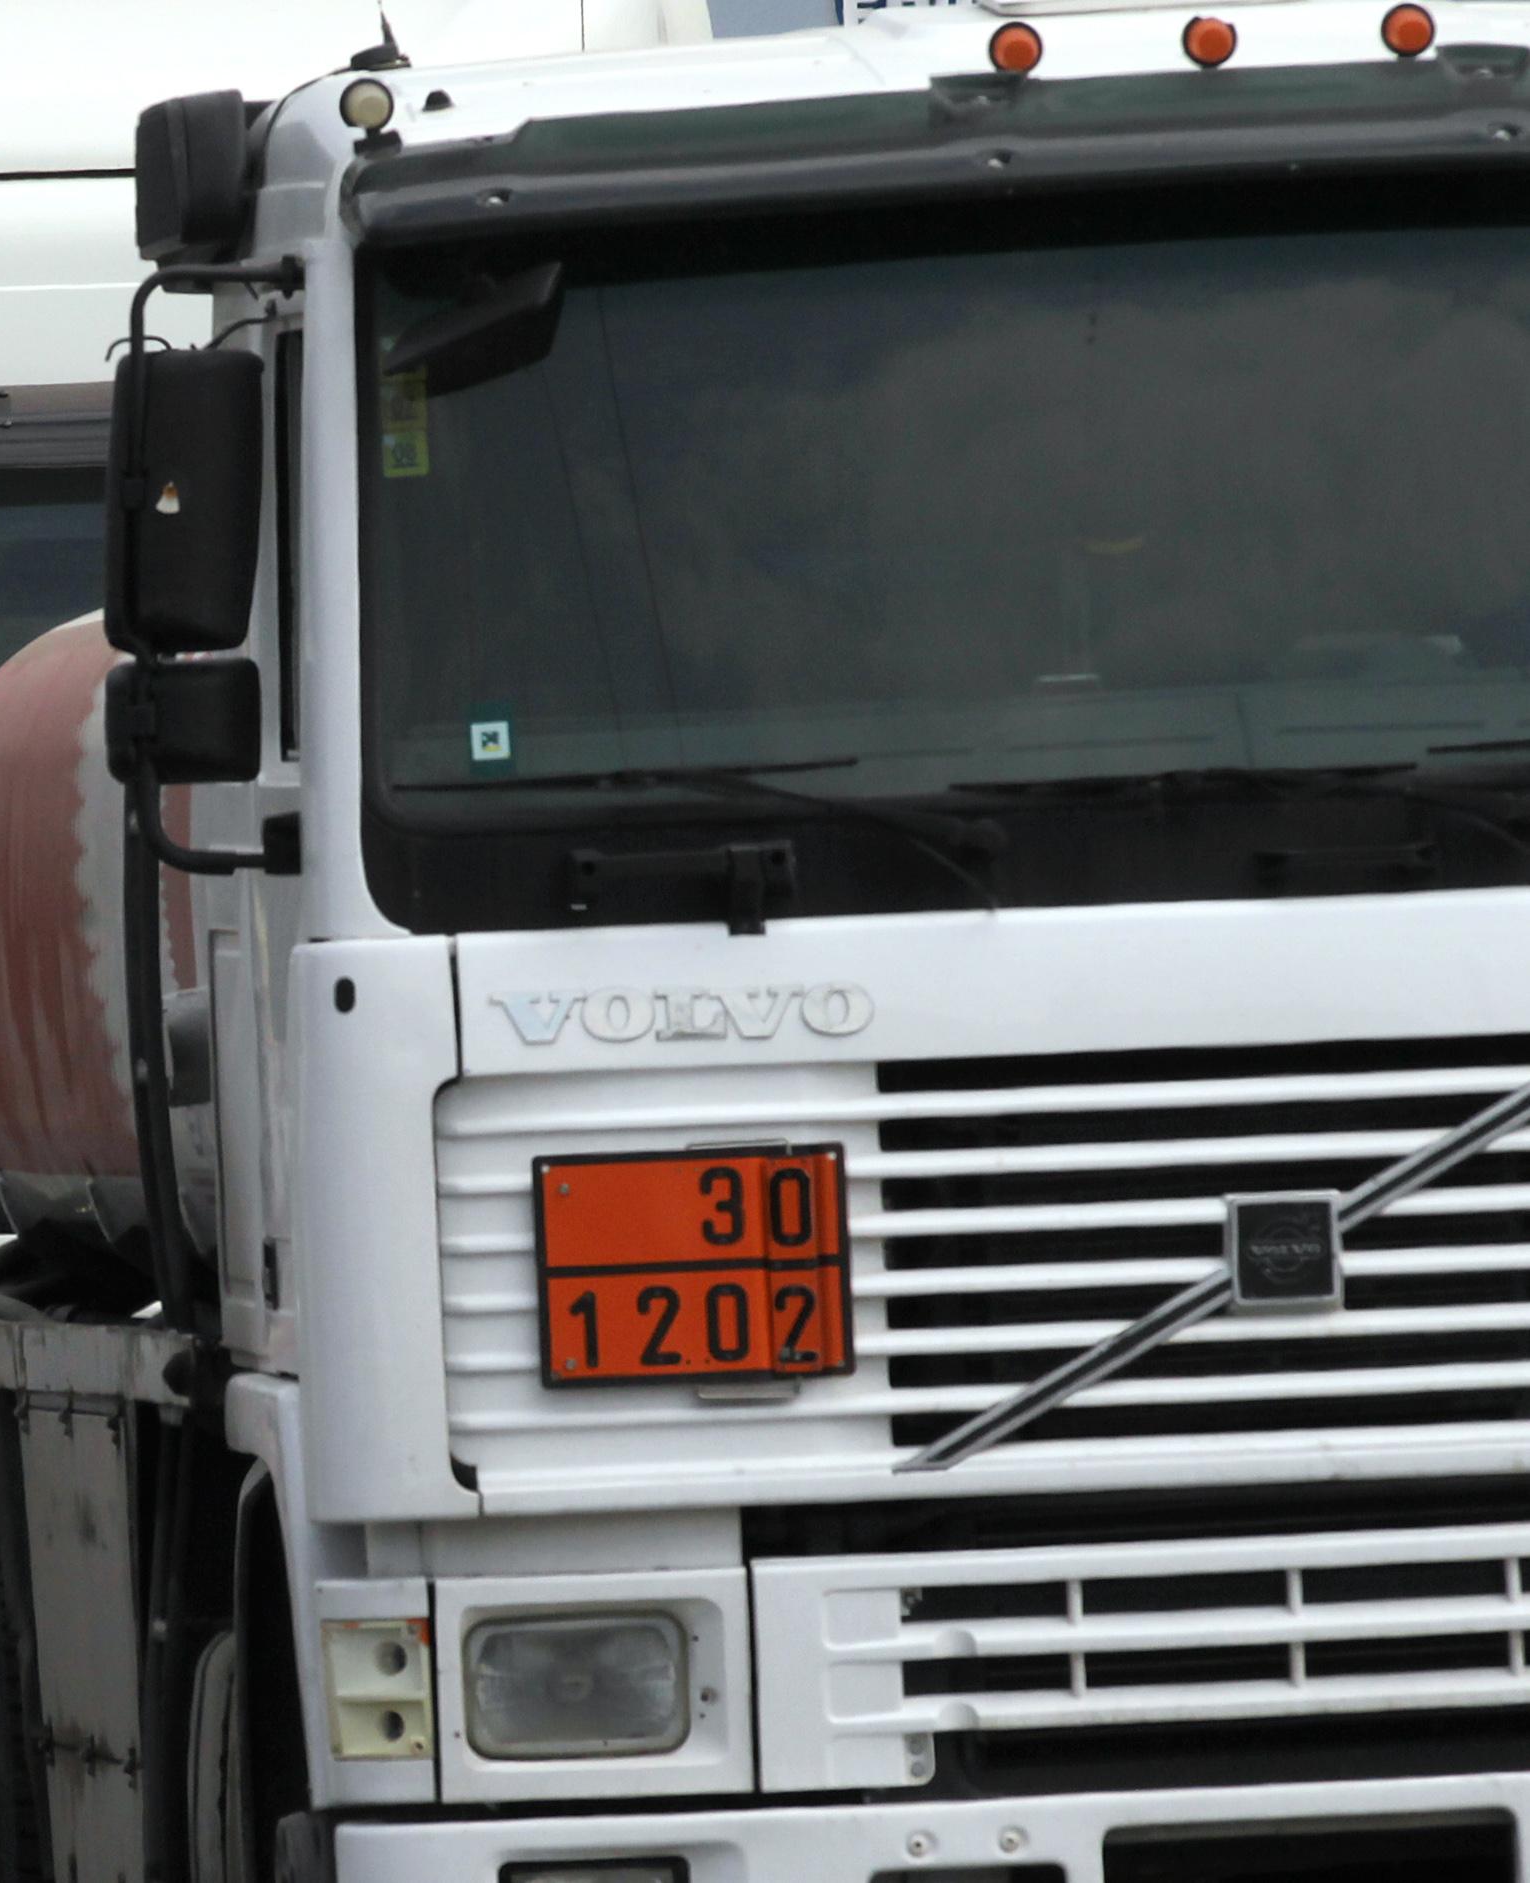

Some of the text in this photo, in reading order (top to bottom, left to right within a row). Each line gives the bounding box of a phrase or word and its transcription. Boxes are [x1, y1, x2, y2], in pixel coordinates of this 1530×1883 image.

[490, 982, 874, 1045] VOLVO
[700, 1167, 812, 1246] 30
[570, 1283, 819, 1367] 1202
